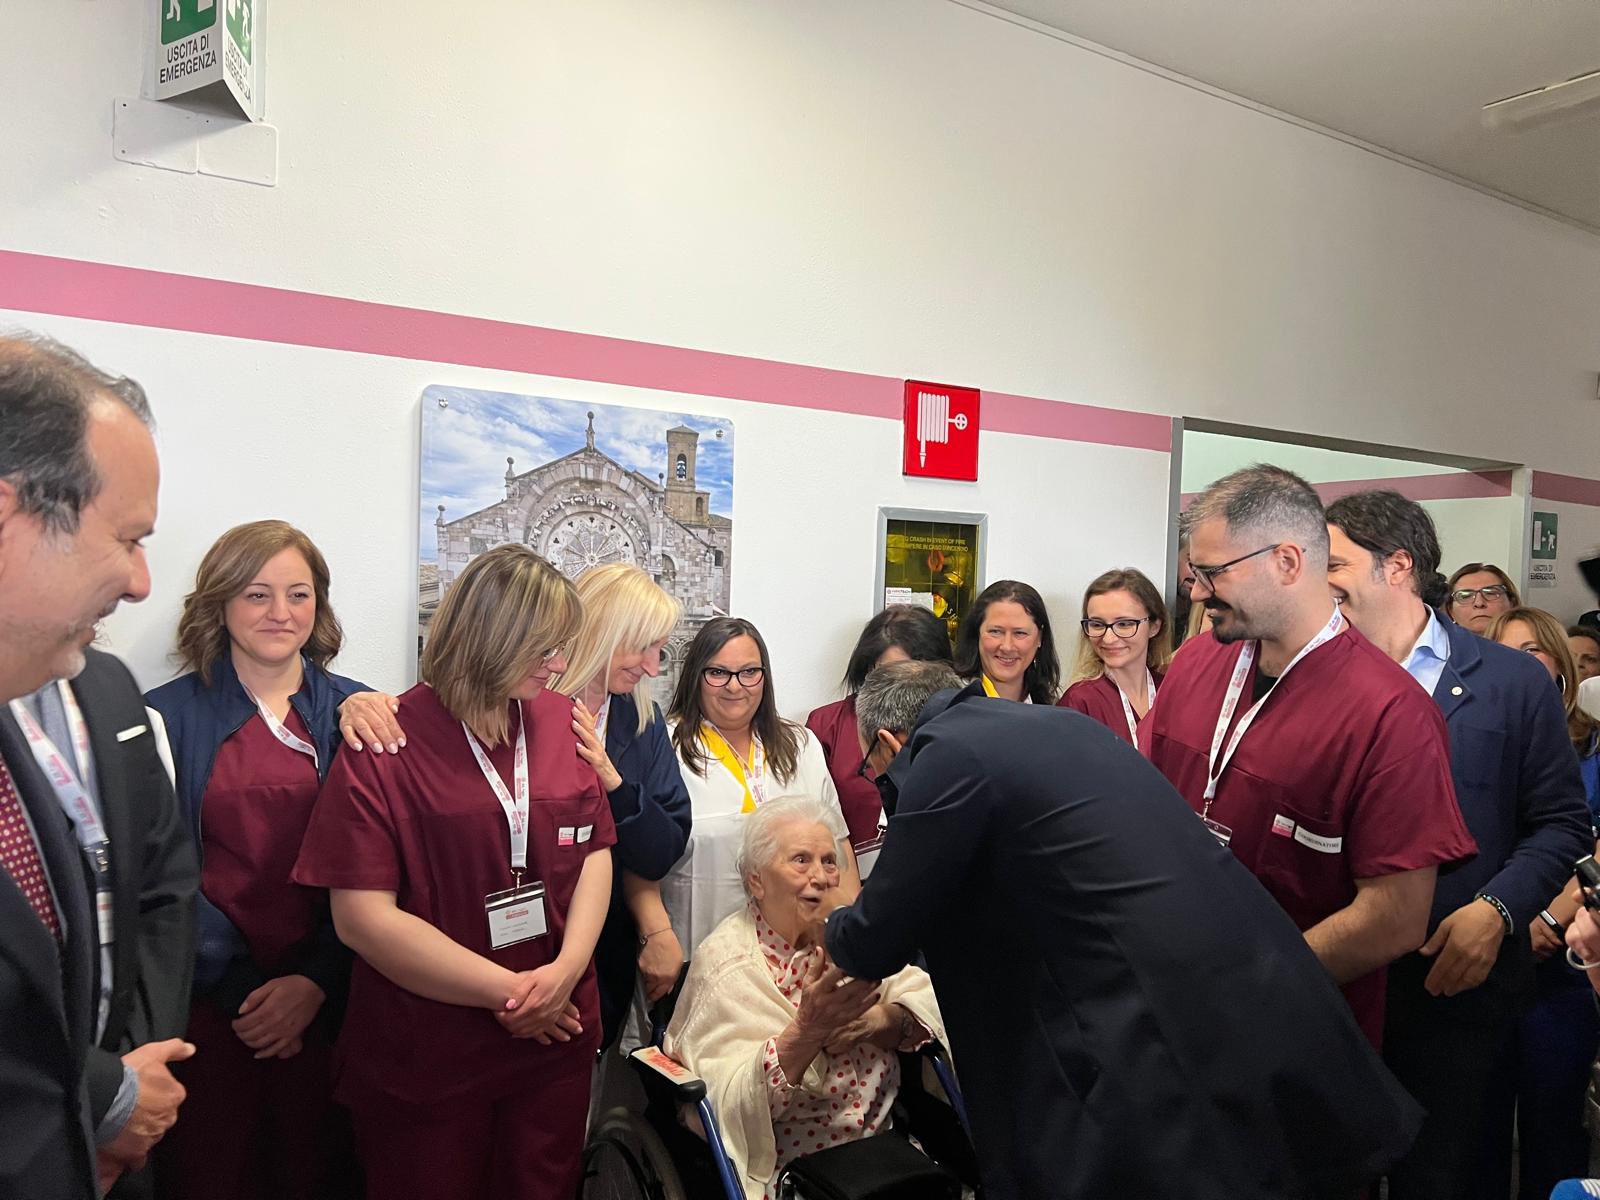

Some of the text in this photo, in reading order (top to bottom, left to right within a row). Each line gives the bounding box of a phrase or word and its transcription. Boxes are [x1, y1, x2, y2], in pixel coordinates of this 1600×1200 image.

[167, 33, 209, 63] USCITA DI
[228, 35, 242, 74] USCITA
[159, 50, 217, 84] EMERGENZA
[225, 49, 251, 105] EMERGENZA
